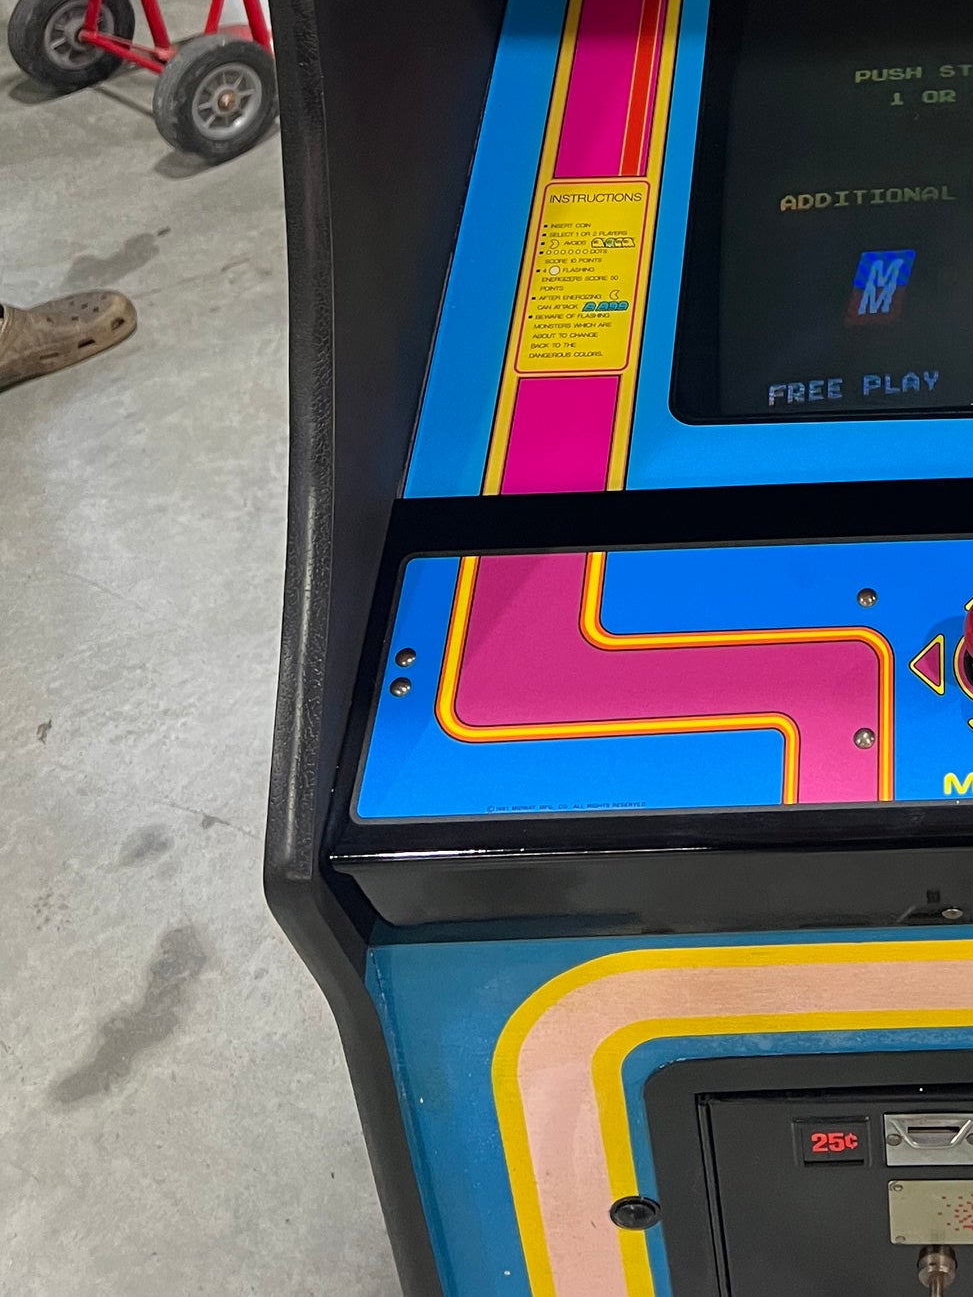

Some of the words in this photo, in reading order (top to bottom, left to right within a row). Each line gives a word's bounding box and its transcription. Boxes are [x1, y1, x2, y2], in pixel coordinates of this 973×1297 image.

[855, 67, 922, 83] PUSH
[890, 92, 904, 106] 1
[922, 90, 957, 104] OR
[549, 192, 643, 204] INSTRUCTIONS
[780, 185, 956, 211] ADDITIONAL
[768, 377, 844, 406] FREE
[863, 370, 940, 397] PLAY
[811, 1132, 859, 1153] 25¢
